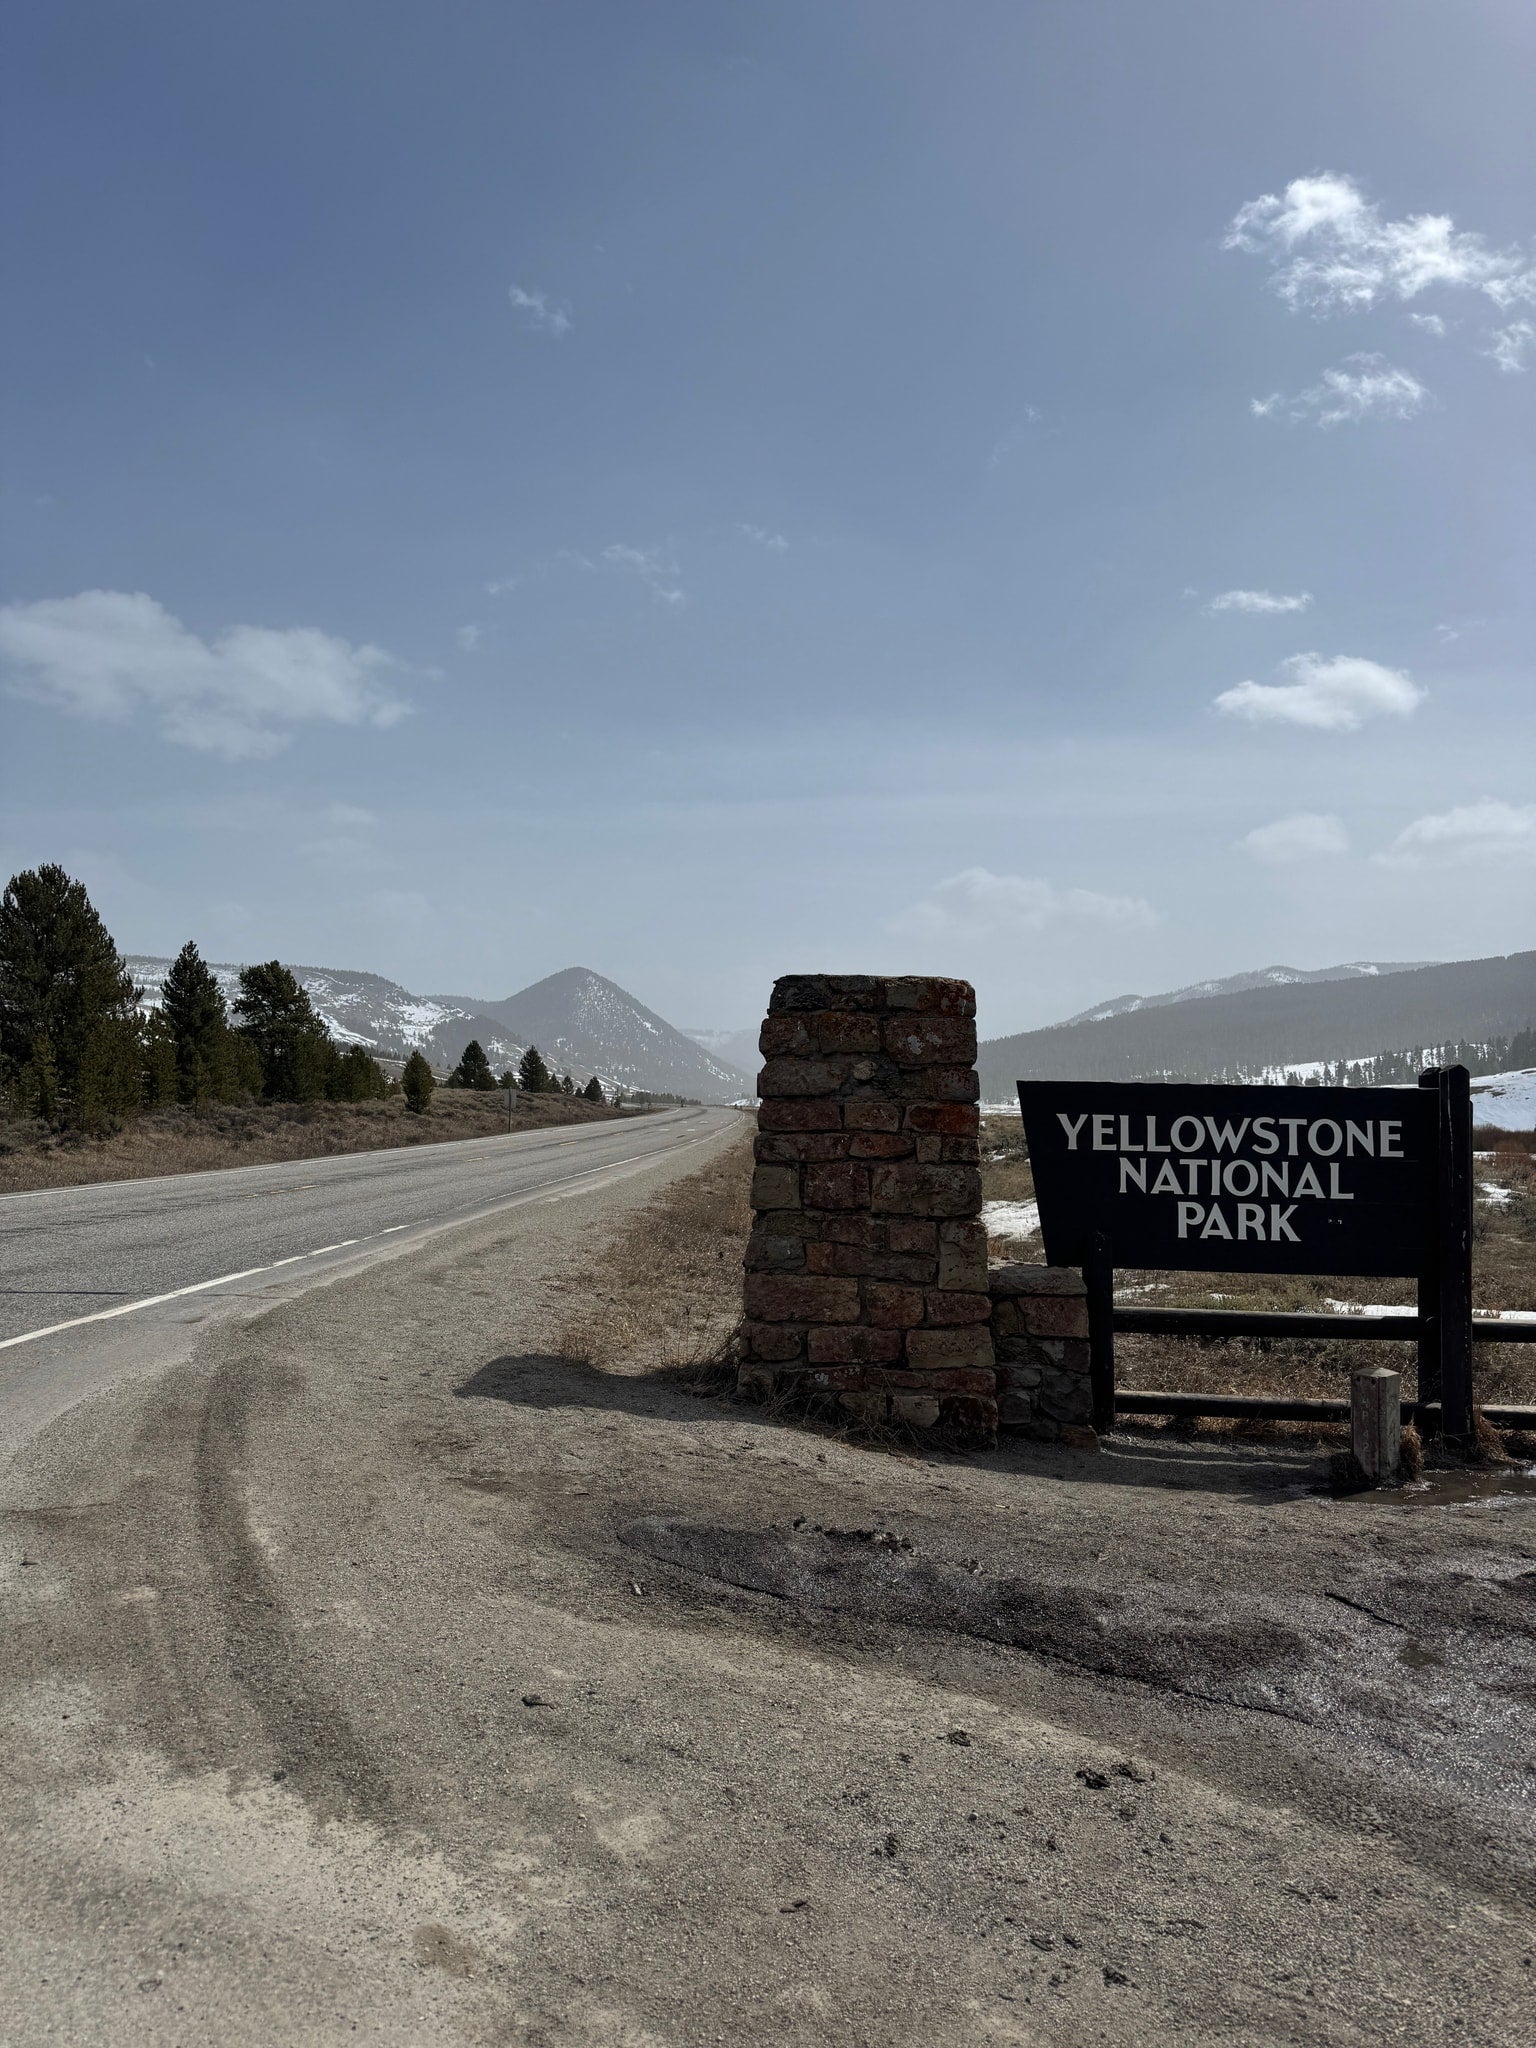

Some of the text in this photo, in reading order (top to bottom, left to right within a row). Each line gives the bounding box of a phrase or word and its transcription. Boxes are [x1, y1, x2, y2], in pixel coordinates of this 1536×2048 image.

[1056, 1113, 1404, 1158] YELLOWSTONE
[1118, 1157, 1354, 1200] NATIONAL
[1177, 1201, 1302, 1242] PARK
